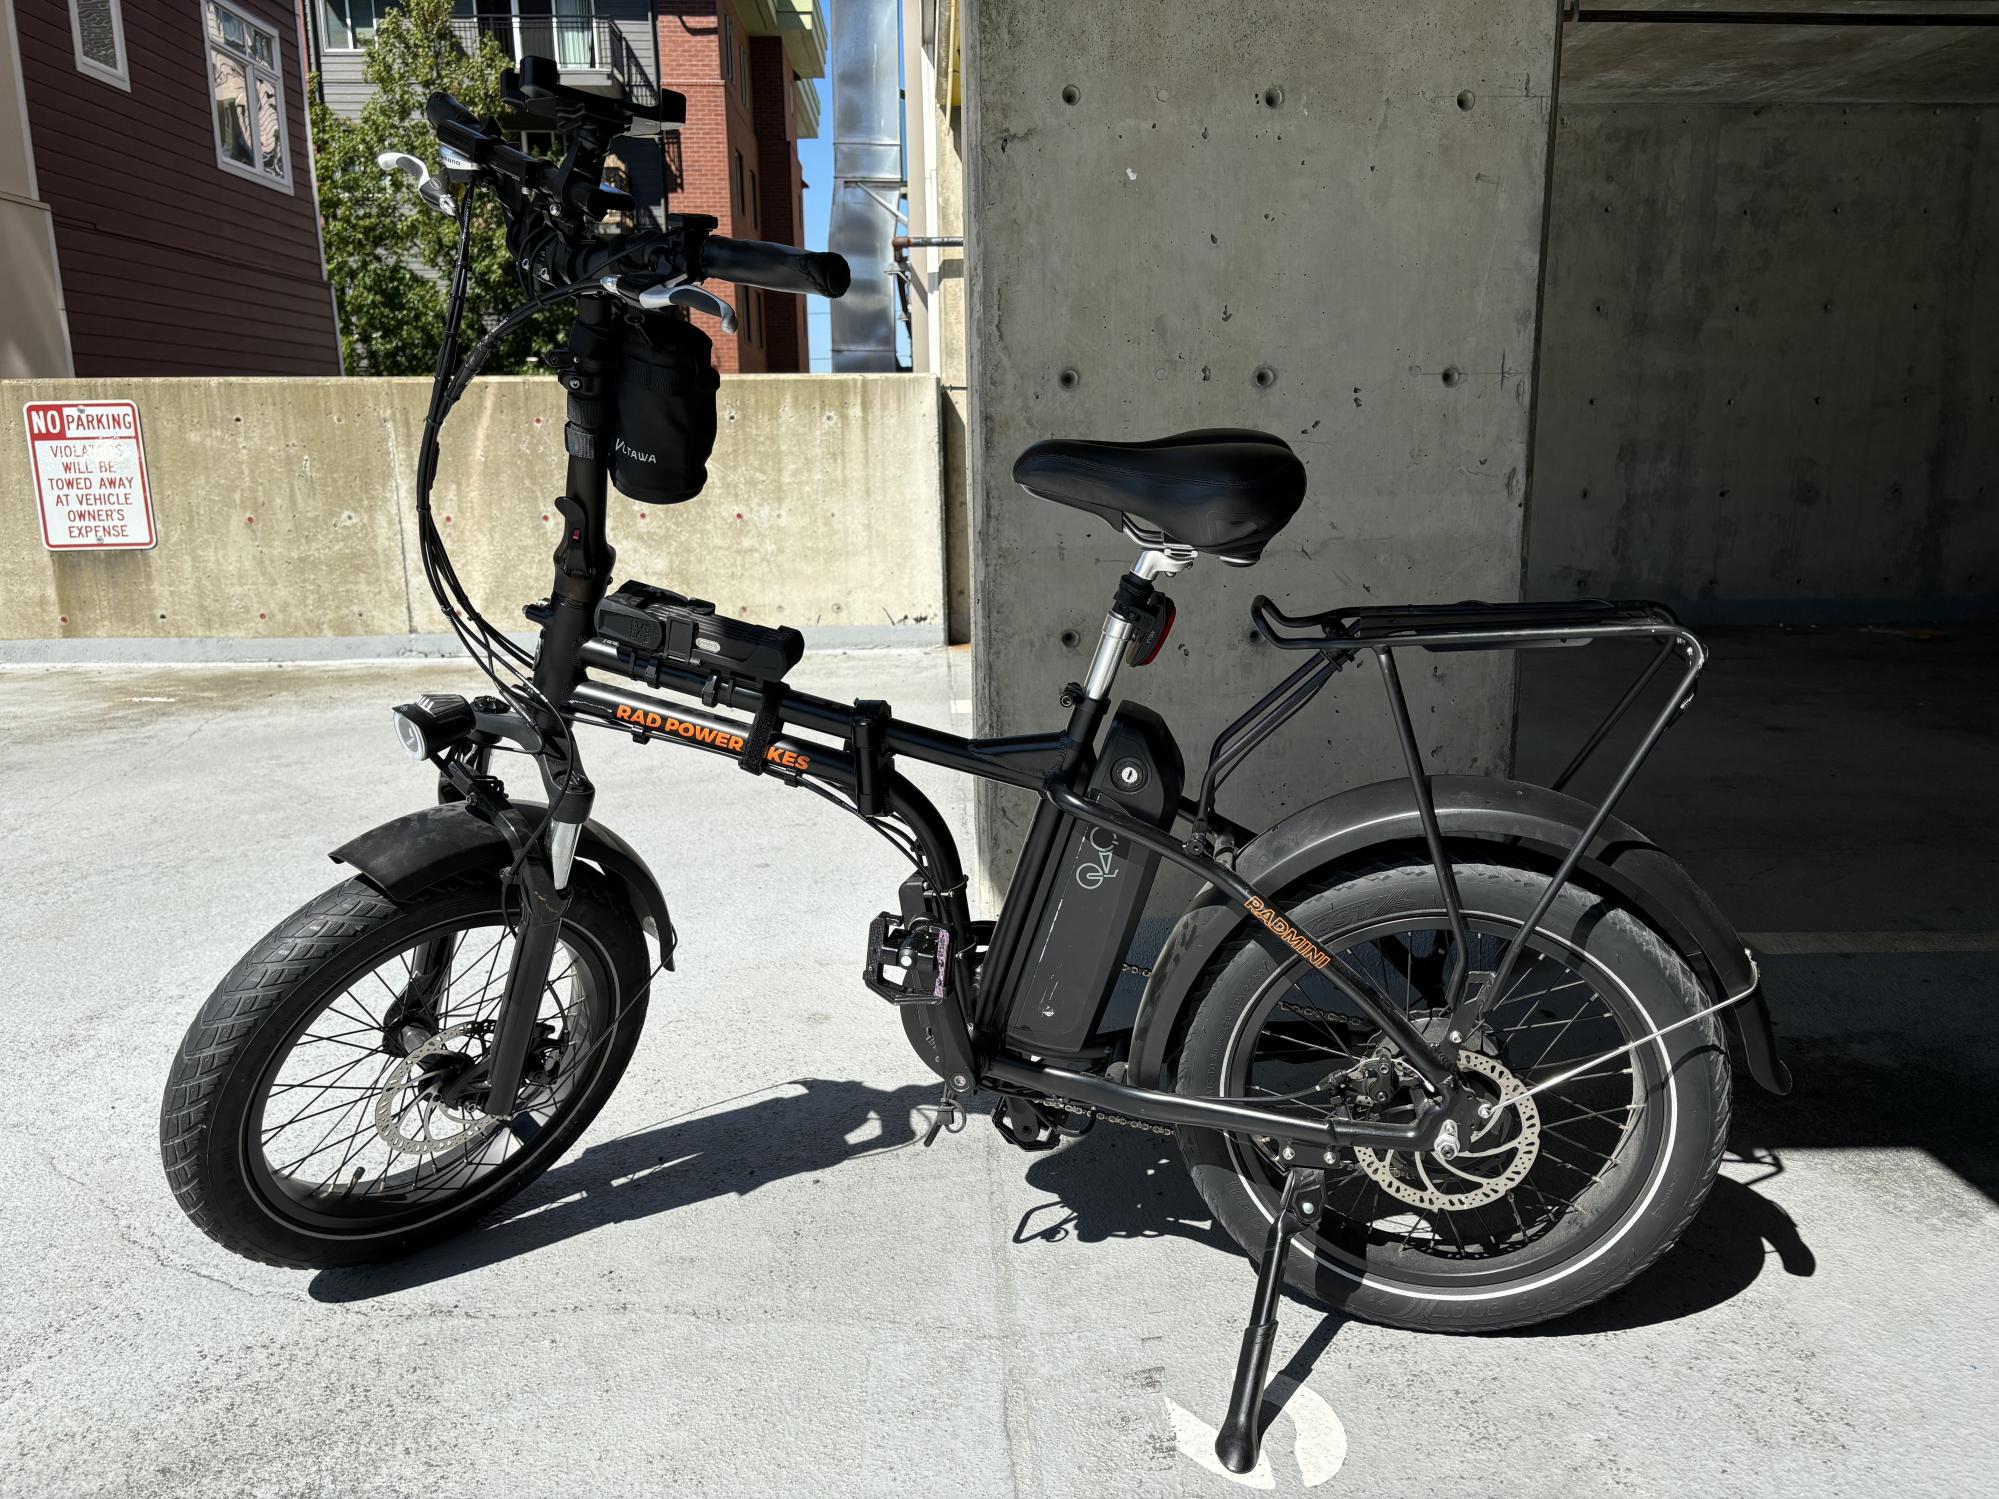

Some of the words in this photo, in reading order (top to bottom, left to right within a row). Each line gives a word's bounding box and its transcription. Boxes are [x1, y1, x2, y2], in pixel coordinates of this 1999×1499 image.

[31, 410, 61, 434] NO
[66, 413, 132, 431] PARKING
[615, 437, 657, 464] VLTAWA
[62, 461, 93, 474] WILL
[99, 461, 116, 474] BE
[48, 478, 93, 490] TOWED
[99, 477, 134, 490] AWAY
[55, 494, 71, 506] AT
[75, 493, 133, 506] VEHICLE
[67, 509, 125, 522] OWNER'S
[68, 525, 129, 538] EXPENSE
[616, 704, 663, 729] RAD
[665, 719, 744, 752] POWER
[766, 746, 810, 770] KES
[1244, 895, 1331, 969] RADMINI
